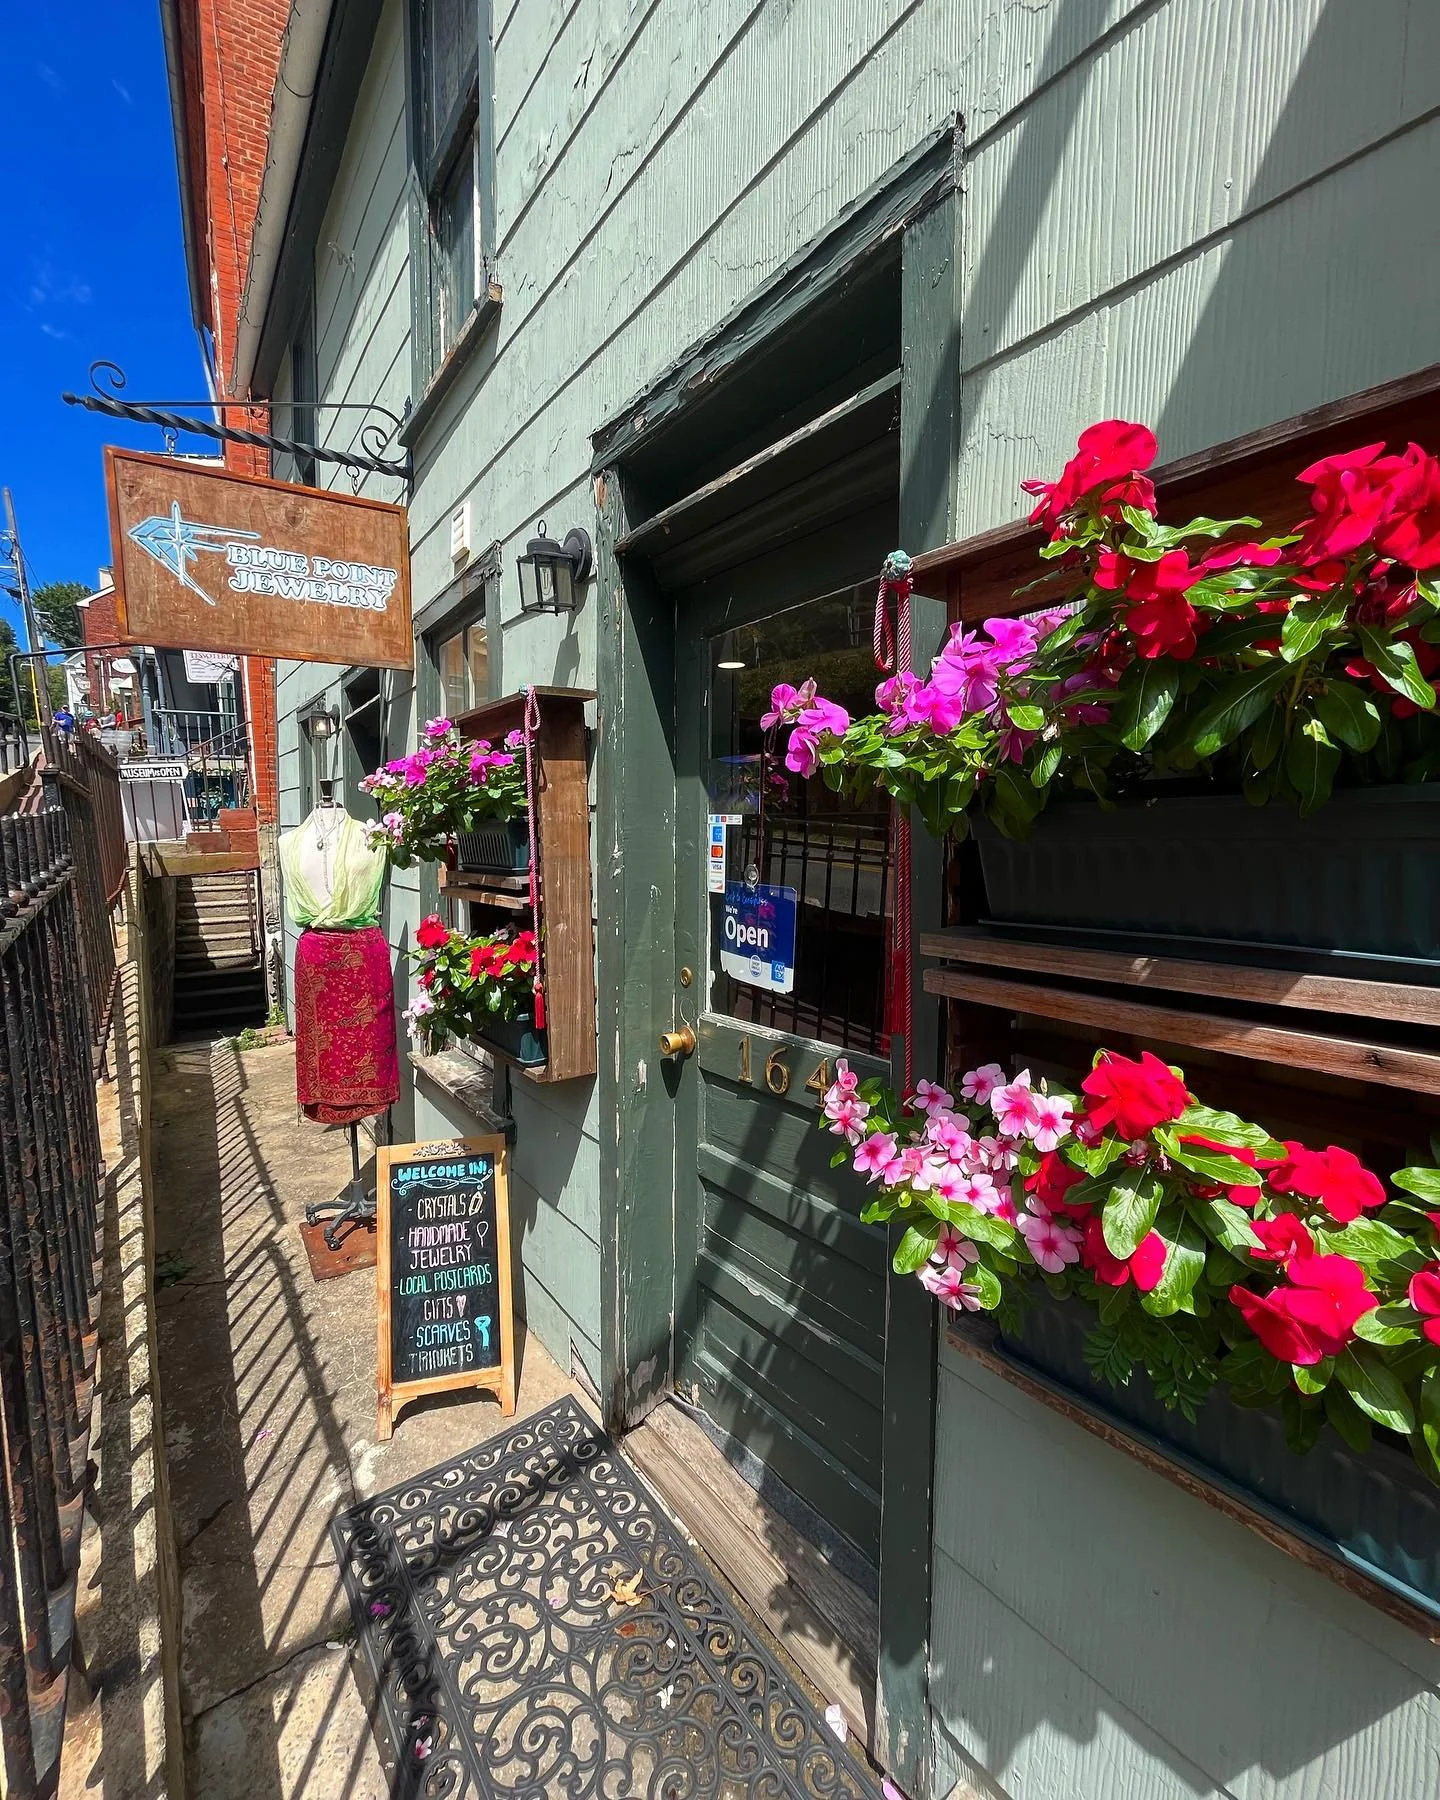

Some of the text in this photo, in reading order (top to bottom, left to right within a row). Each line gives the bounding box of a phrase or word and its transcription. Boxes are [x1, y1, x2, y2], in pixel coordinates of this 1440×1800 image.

[227, 542, 397, 588] BLUE POINT
[228, 568, 391, 611] JEWELRY
[121, 768, 155, 778] MUSEUM
[160, 767, 180, 777] OPEN
[725, 905, 738, 914] We're
[725, 916, 768, 948] Open
[738, 1034, 829, 1108] 164
[397, 1160, 488, 1181] WELCOME IN!
[417, 1193, 466, 1220] CRYSTALS
[408, 1221, 471, 1248] HANDMADE
[409, 1243, 473, 1270] JEWELRY
[433, 1263, 492, 1292] POSTCARDS
[424, 1296, 453, 1321] GIFTS
[416, 1320, 471, 1348] SCARVES
[408, 1343, 474, 1373] TRINKETS
